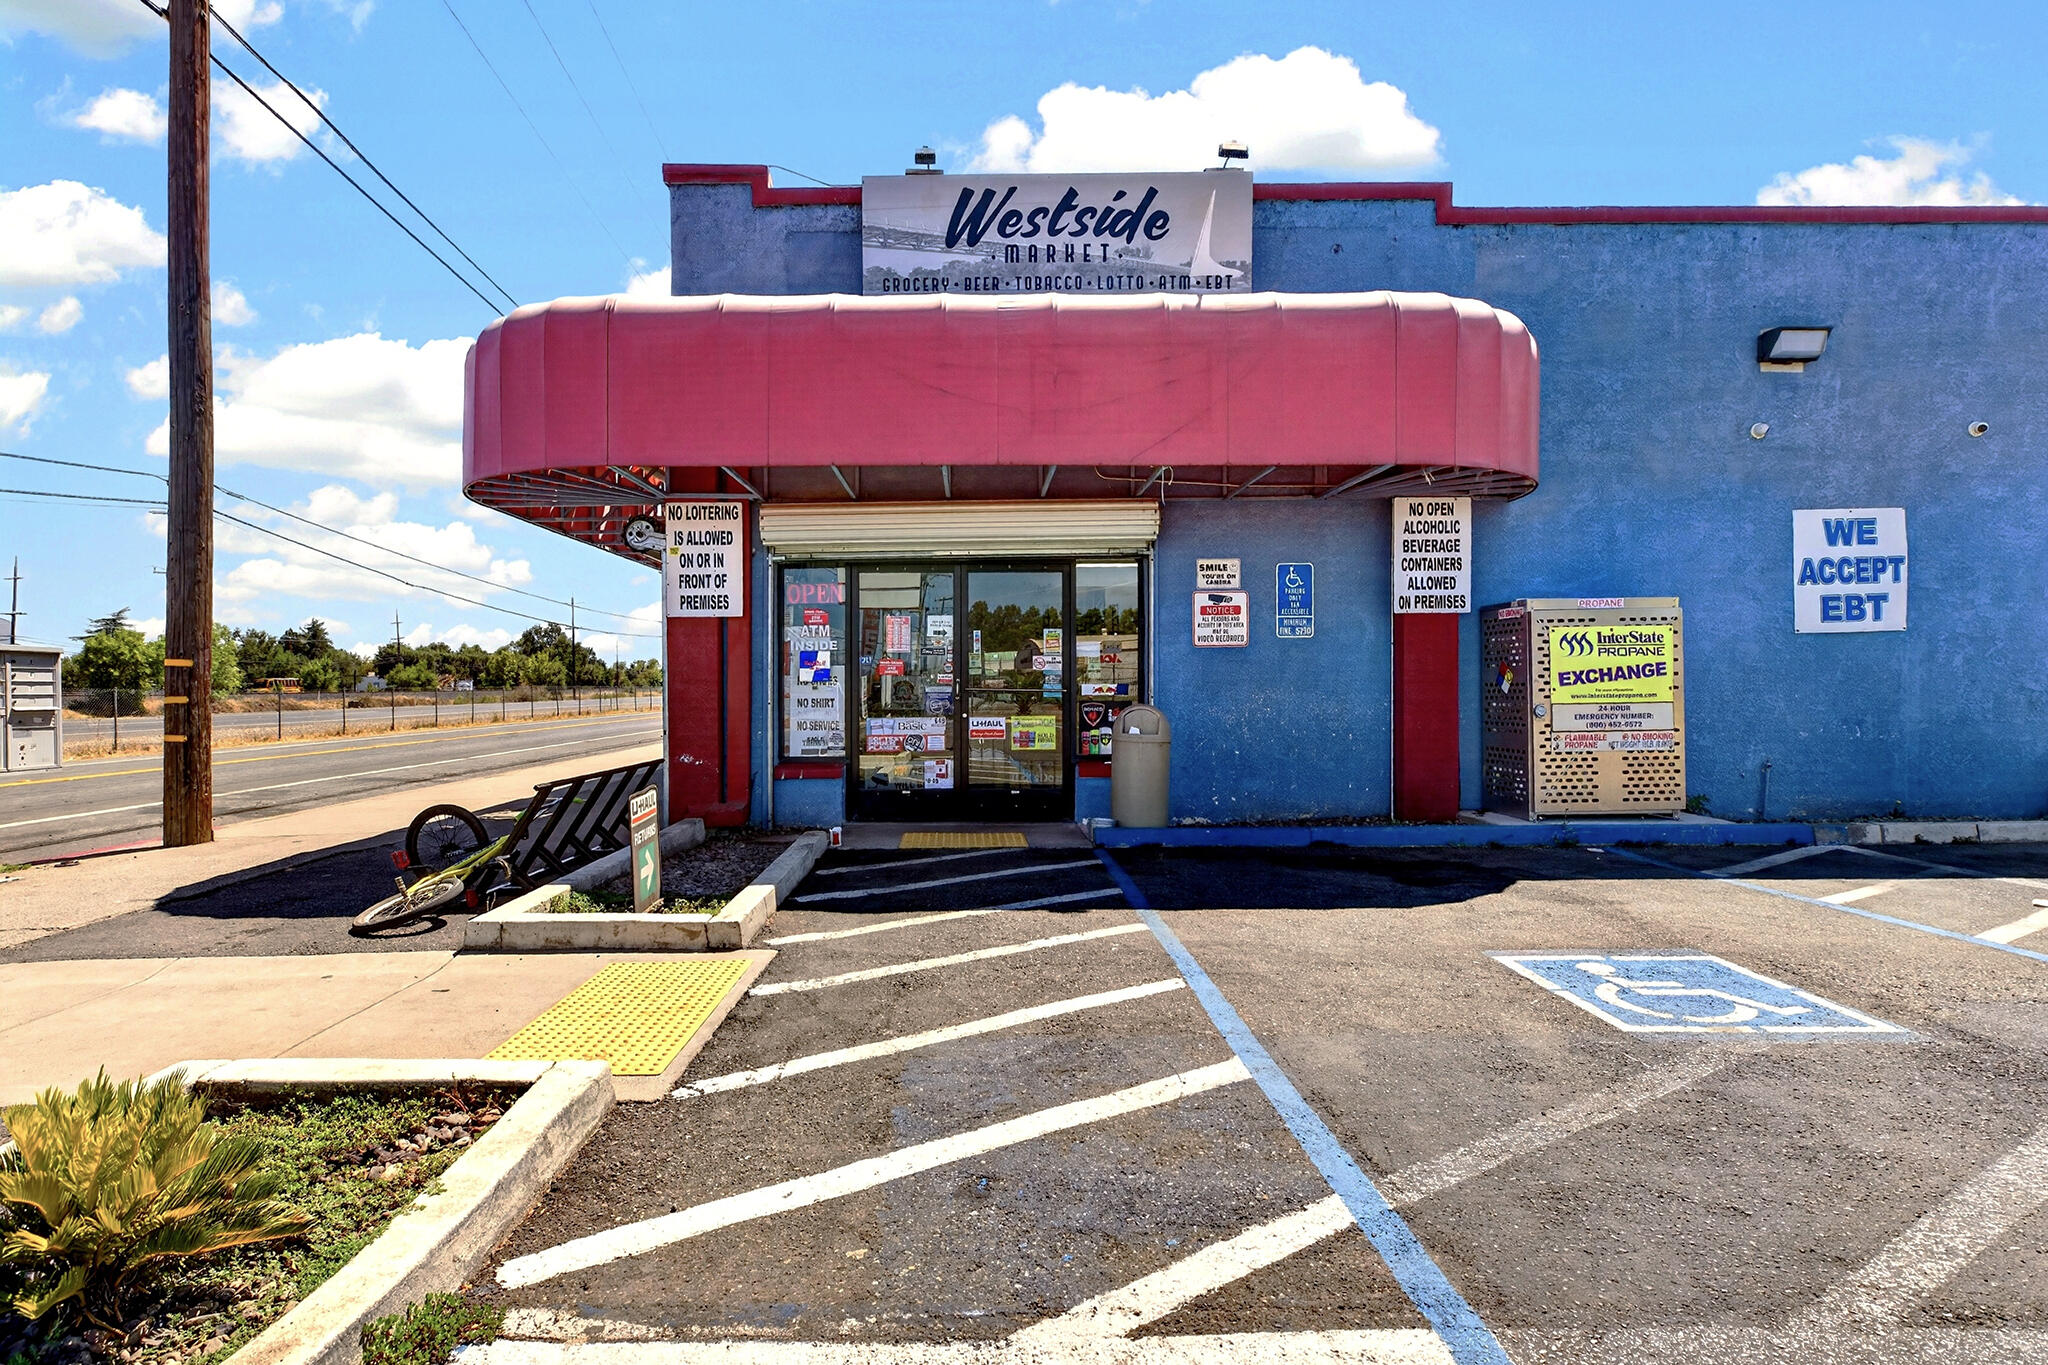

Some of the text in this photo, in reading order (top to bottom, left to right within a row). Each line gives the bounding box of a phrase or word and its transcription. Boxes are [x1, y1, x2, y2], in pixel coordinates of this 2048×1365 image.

[945, 186, 1170, 249] Westside
[1004, 243, 1110, 264] MARKET
[882, 275, 1234, 292] GROCERY BEER TOBACCO LOTTO ATM EBT
[668, 505, 739, 521] NO LOITERING
[1409, 502, 1455, 516] NO OPEN
[1403, 520, 1461, 535] ALCOHOLIC
[1822, 517, 1878, 547] WE
[674, 530, 734, 546] IS ALLOWED
[1402, 539, 1461, 553] BEVERAGE
[679, 553, 724, 569] ON OR IN
[1199, 563, 1228, 572] SMILE
[1401, 557, 1463, 571] CONTAINERS
[1797, 555, 1906, 586] ACCEPT
[678, 573, 727, 589] FRONT OF
[1407, 576, 1457, 590] ALLOWED
[787, 583, 844, 604] OPEN
[679, 594, 730, 610] PREMISES
[1398, 594, 1466, 609] ON PREMISES
[1579, 599, 1623, 608] PROPANE
[1820, 593, 1889, 623] EBT
[1206, 606, 1235, 615] NOTICE
[800, 625, 830, 637] ATM
[1215, 634, 1245, 642] RECORDED
[1597, 631, 1664, 644] InterState
[790, 640, 838, 651] INSIDE
[1597, 646, 1666, 657] PROPANE
[1558, 662, 1668, 687] EXCHANGE
[797, 698, 835, 708] NO SHIRT
[796, 720, 840, 731] NO SERVICE
[897, 722, 928, 730] Basic
[1642, 732, 1674, 740] SMOKING
[1564, 741, 1598, 749] PROPANE
[635, 823, 656, 845] RETURNS
